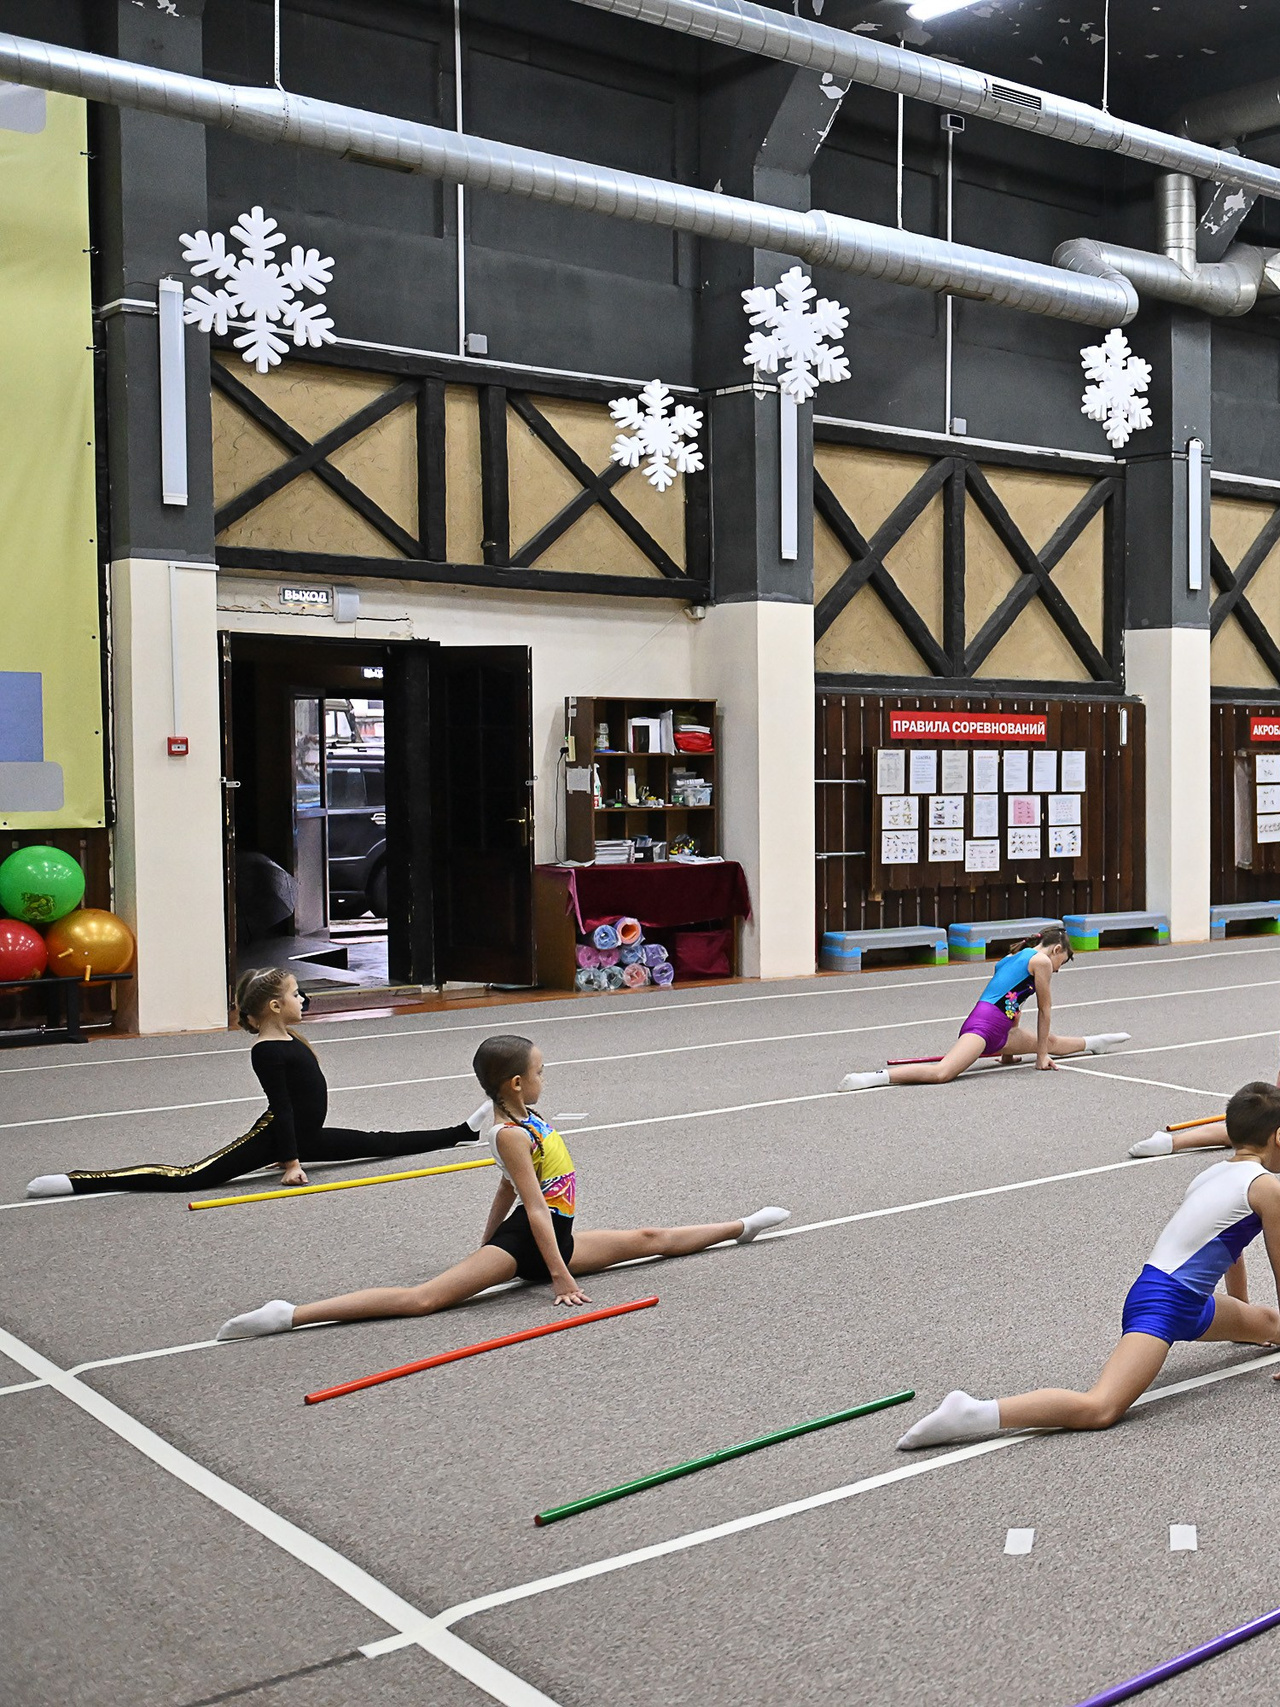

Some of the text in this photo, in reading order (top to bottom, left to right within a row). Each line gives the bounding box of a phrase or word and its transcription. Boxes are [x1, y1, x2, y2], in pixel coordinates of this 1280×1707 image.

[284, 589, 328, 602] ВЫХОД
[892, 720, 1046, 735] ПРАВИЛА СОРЕВНОВАНИЙ
